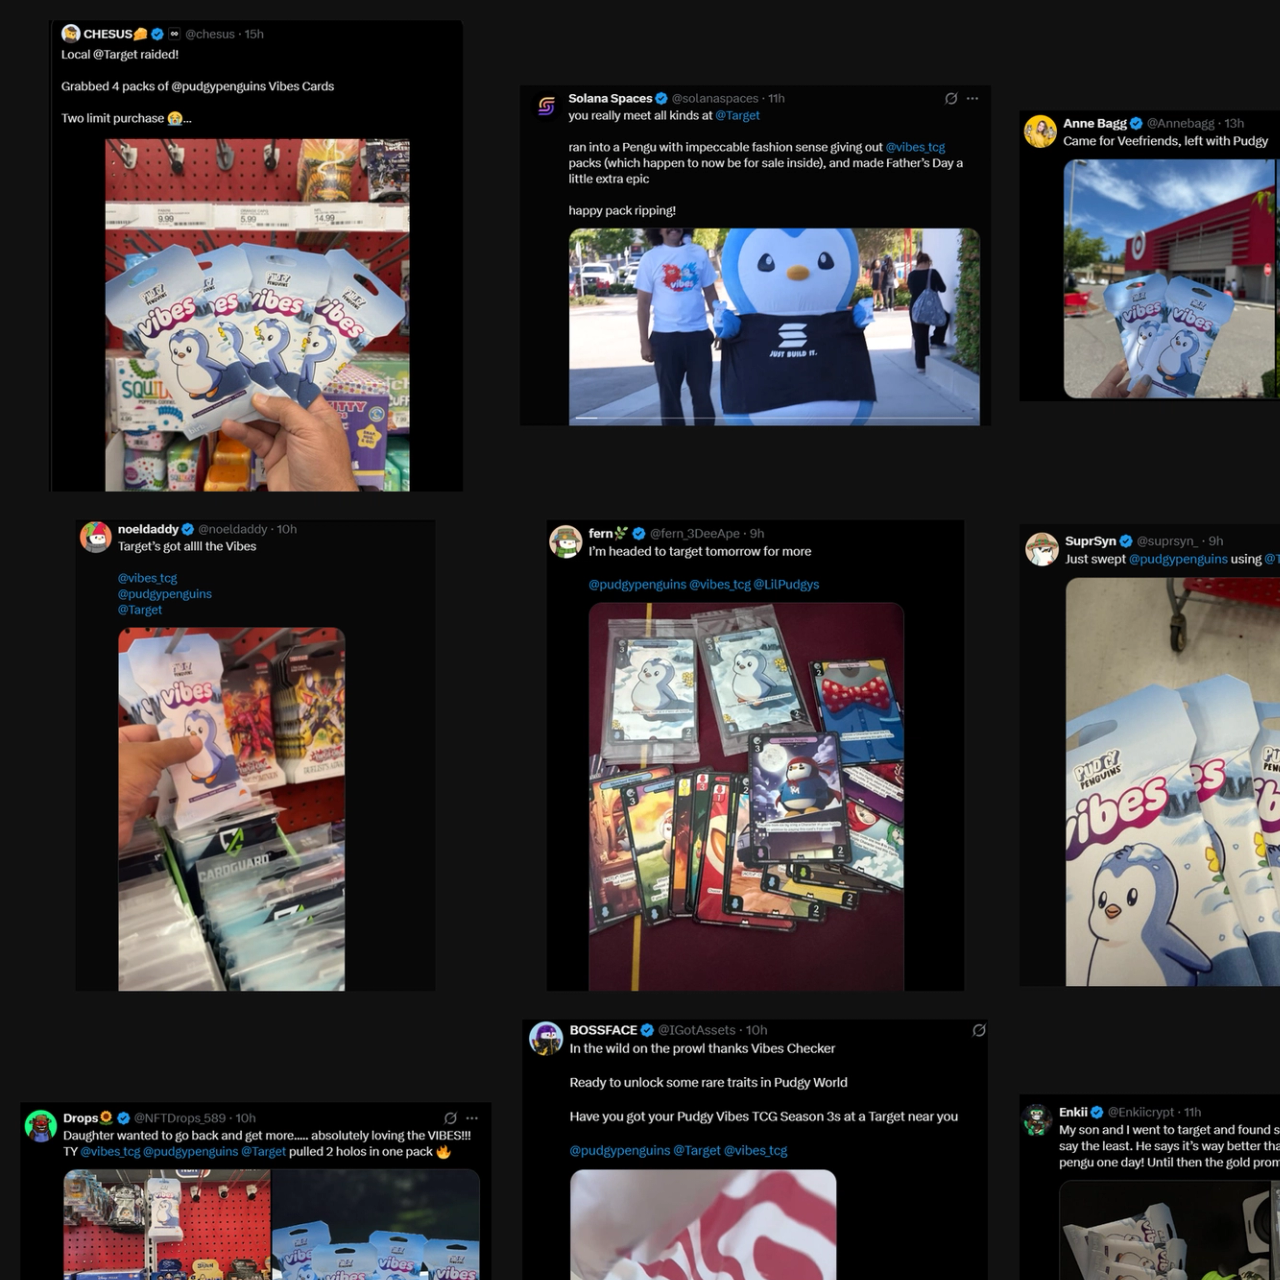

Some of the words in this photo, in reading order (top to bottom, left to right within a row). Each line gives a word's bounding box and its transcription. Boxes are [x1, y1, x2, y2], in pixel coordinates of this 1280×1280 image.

[62, 50, 90, 59] Local
[93, 49, 137, 61] @Target
[141, 49, 178, 59] raided!
[569, 93, 608, 103] Solana
[611, 94, 652, 105] Spaces
[1064, 119, 1094, 128] Anne
[1098, 119, 1127, 130] Bagg
[569, 206, 603, 217] happy
[606, 206, 632, 217] pack
[635, 205, 675, 217] ripping!
[138, 296, 196, 338] vibes
[118, 524, 179, 536] noeldaddy
[1066, 536, 1116, 548] SuprSyn
[570, 1025, 637, 1035] BOSSFACE
[1060, 1107, 1087, 1117] Enkii
